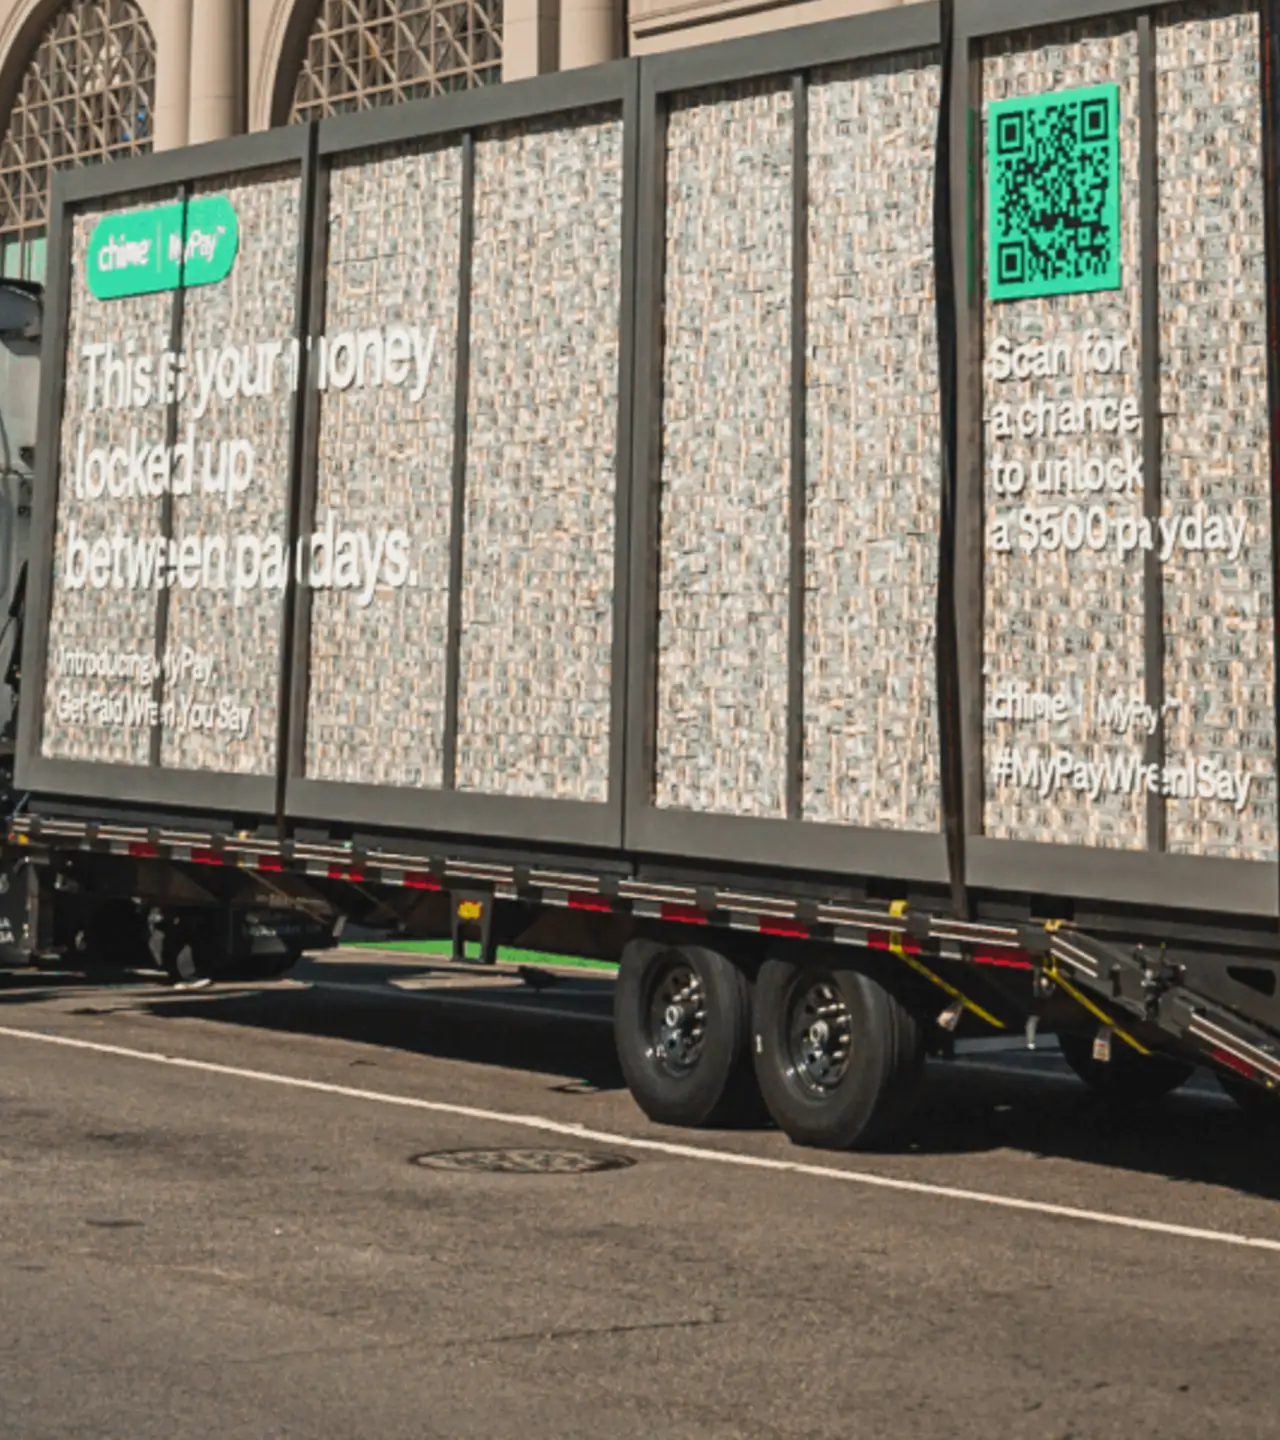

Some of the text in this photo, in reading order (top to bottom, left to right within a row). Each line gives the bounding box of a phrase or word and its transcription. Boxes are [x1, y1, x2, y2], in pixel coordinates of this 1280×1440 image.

[98, 233, 152, 272] chime
[82, 340, 152, 411] This
[191, 338, 282, 420] your
[989, 327, 1127, 380] Scan for
[991, 391, 1140, 437] a chance
[75, 421, 254, 510] locked up
[991, 444, 1144, 494] to unlock
[67, 519, 227, 590] between
[991, 502, 1246, 560] a $500 payday
[179, 693, 216, 733] You
[219, 694, 252, 740] Say
[991, 680, 1067, 721] chime
